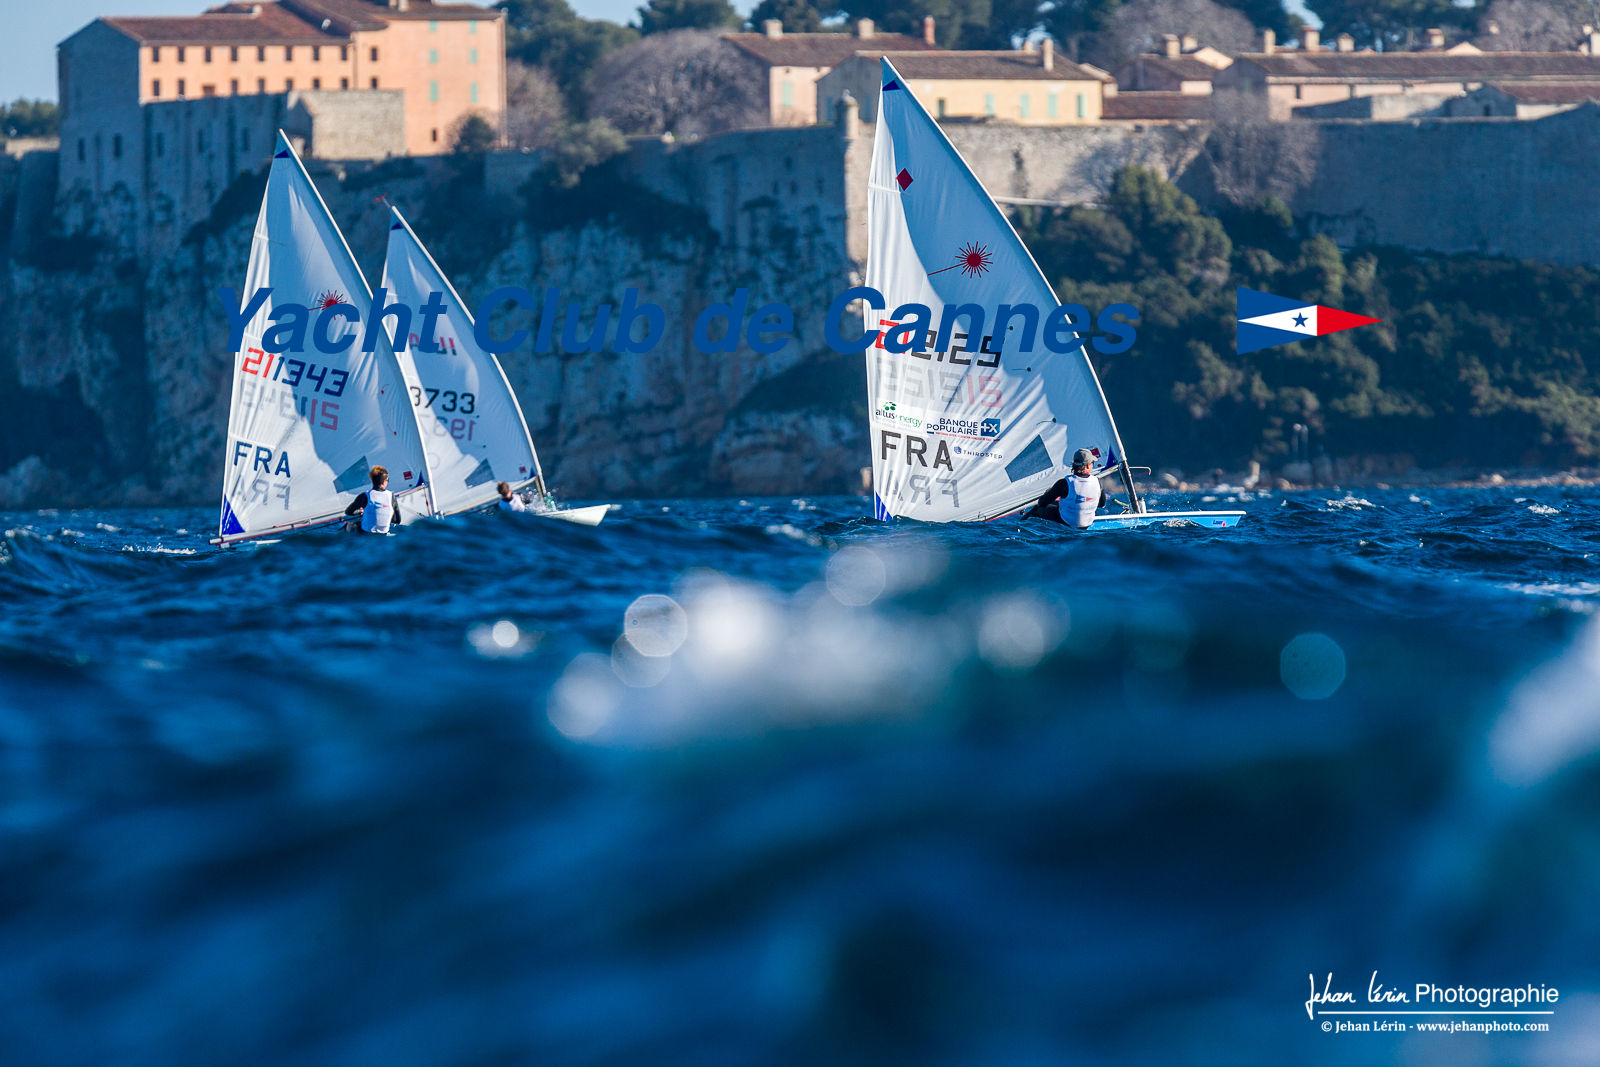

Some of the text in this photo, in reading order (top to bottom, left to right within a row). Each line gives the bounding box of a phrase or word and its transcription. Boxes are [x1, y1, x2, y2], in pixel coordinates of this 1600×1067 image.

[242, 347, 349, 397] 211343
[926, 423, 978, 436] POPULAIRE
[939, 417, 979, 430] BANQUE
[233, 440, 291, 478] FRA
[881, 430, 954, 472] FRA
